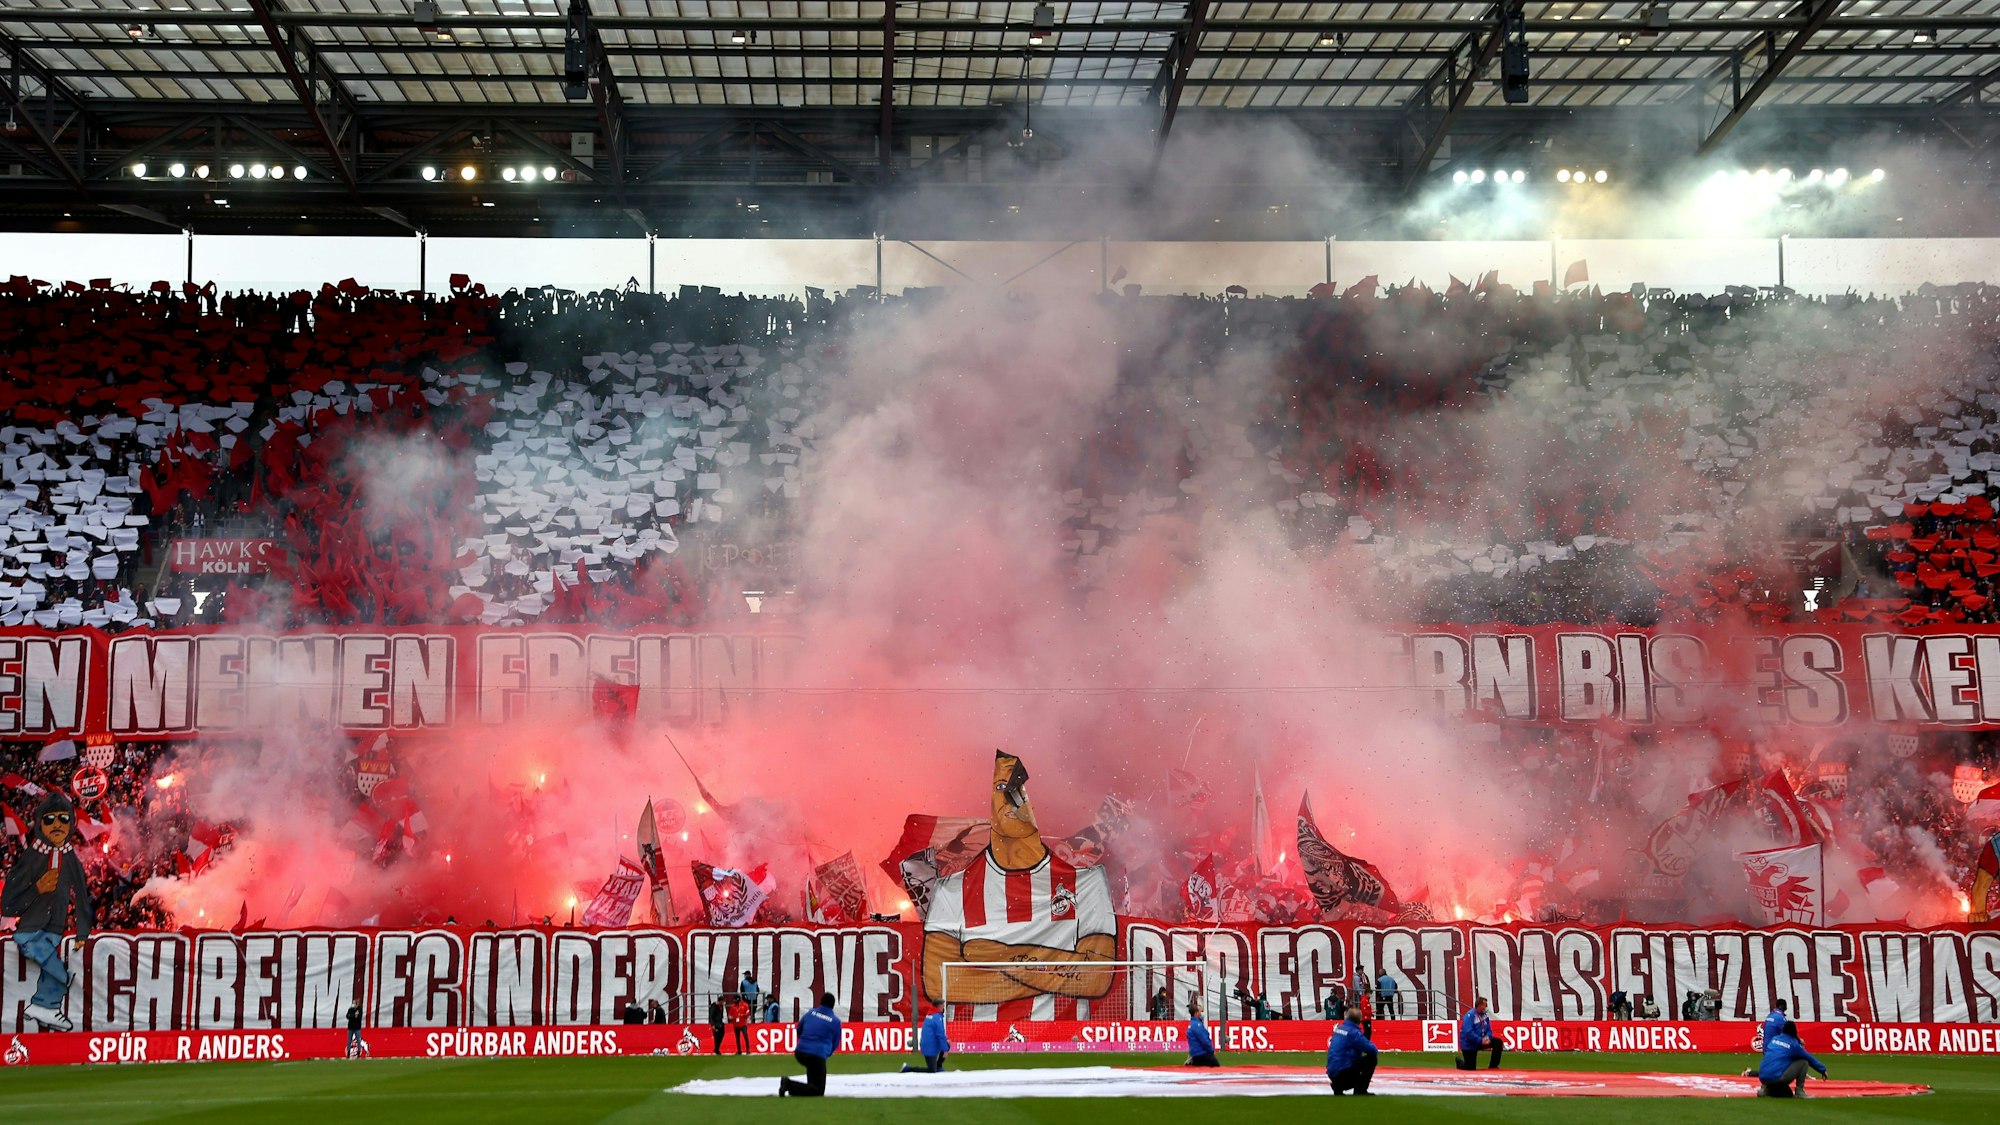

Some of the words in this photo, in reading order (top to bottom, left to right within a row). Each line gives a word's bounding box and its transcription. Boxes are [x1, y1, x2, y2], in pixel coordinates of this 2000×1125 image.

[202, 560, 250, 574] KÖLN
[107, 632, 456, 736] MEINEN
[1557, 632, 1707, 725] BIS
[1732, 633, 1849, 727] ES
[61, 933, 191, 1032] ICH
[196, 931, 369, 1030] BEIM
[375, 931, 465, 1029] FC
[467, 929, 547, 1027] IN
[551, 929, 684, 1026] DER
[687, 928, 903, 1024] KURVE
[1127, 922, 1251, 1021] DER
[1258, 925, 1347, 1021] FC
[1353, 926, 1464, 1021] IST
[1471, 928, 1604, 1022] DAS
[1612, 930, 1858, 1023] EINZIGE
[1859, 929, 2000, 1024] WAS
[427, 1028, 526, 1056] SPÜRBAR
[533, 1030, 623, 1054] ANDERS.
[1081, 1022, 1179, 1042] SPÜRBAR
[1608, 1027, 1697, 1050] ANDERS.
[1831, 1023, 1932, 1052] SPÜRBAR
[198, 1034, 290, 1060] ANDERS.
